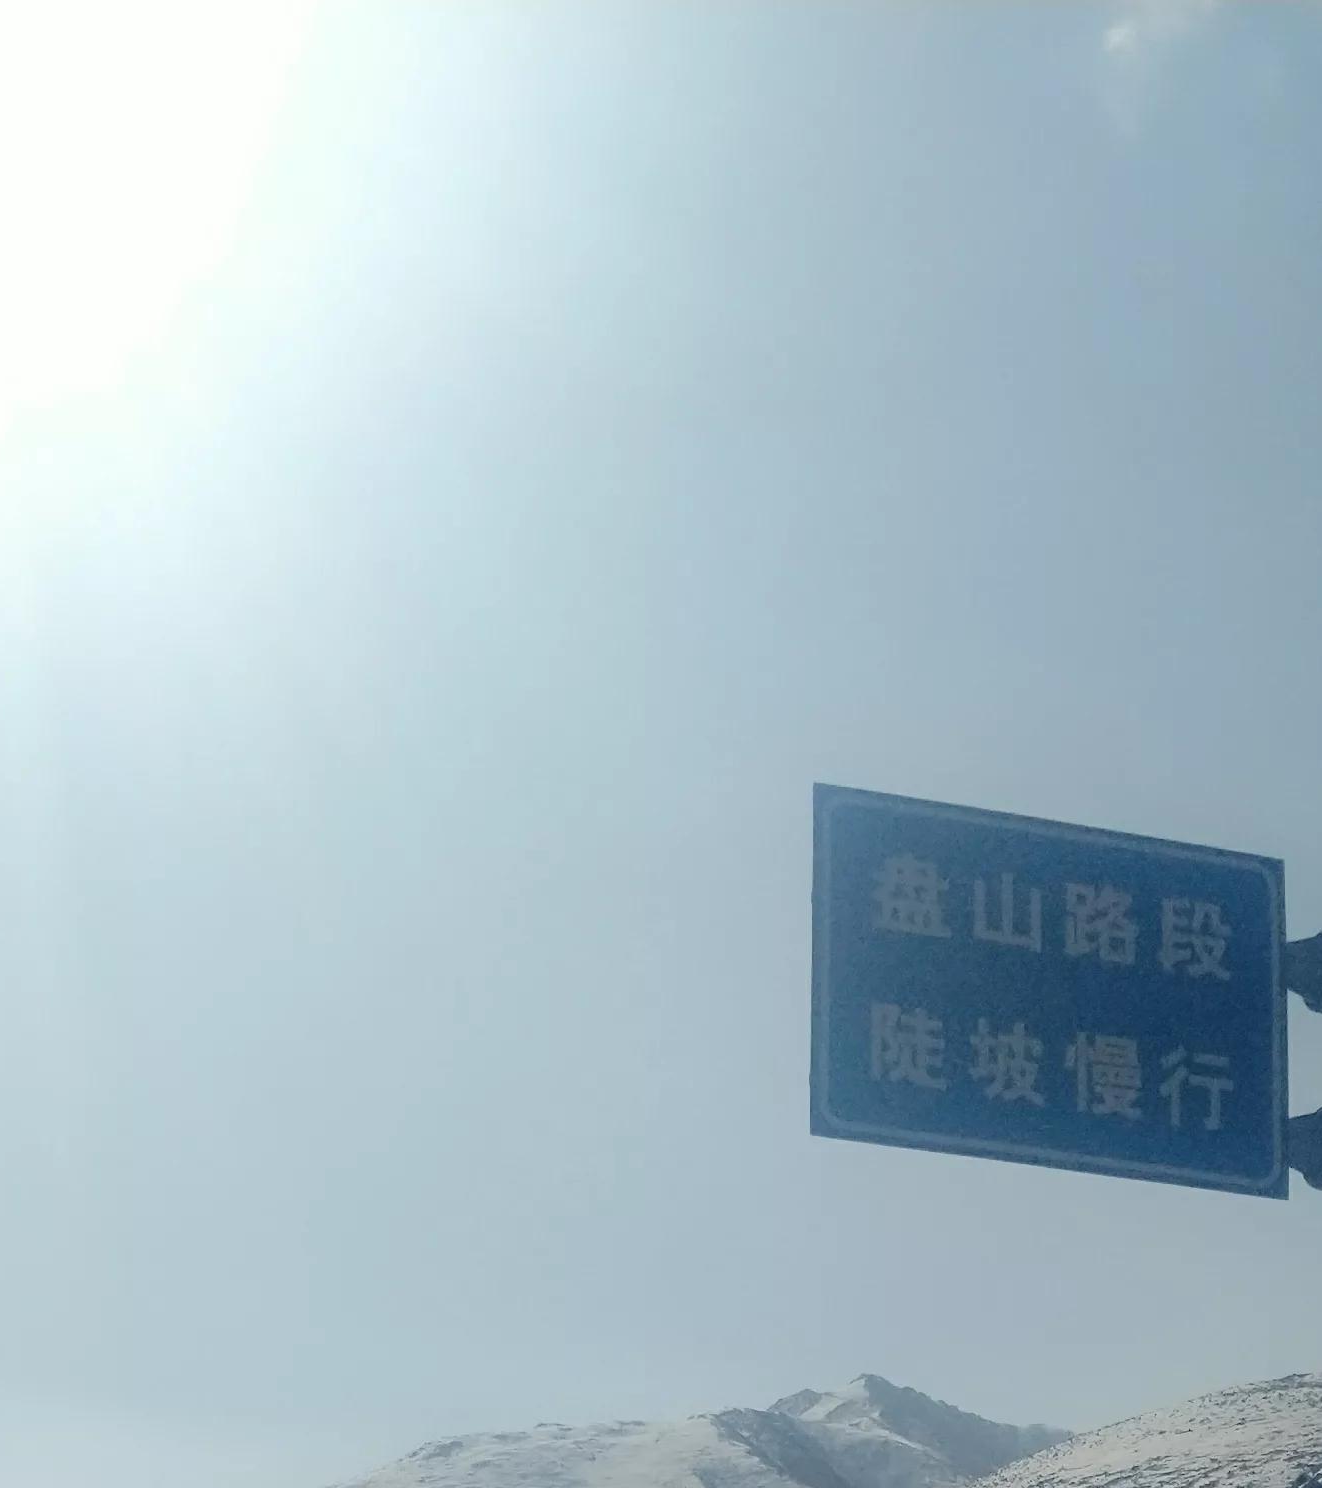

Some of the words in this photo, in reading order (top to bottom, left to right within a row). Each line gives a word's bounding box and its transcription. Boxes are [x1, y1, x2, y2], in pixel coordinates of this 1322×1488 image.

[873, 852, 1232, 981] 盘山路段
[868, 1004, 1234, 1131] 陡坡慢行
